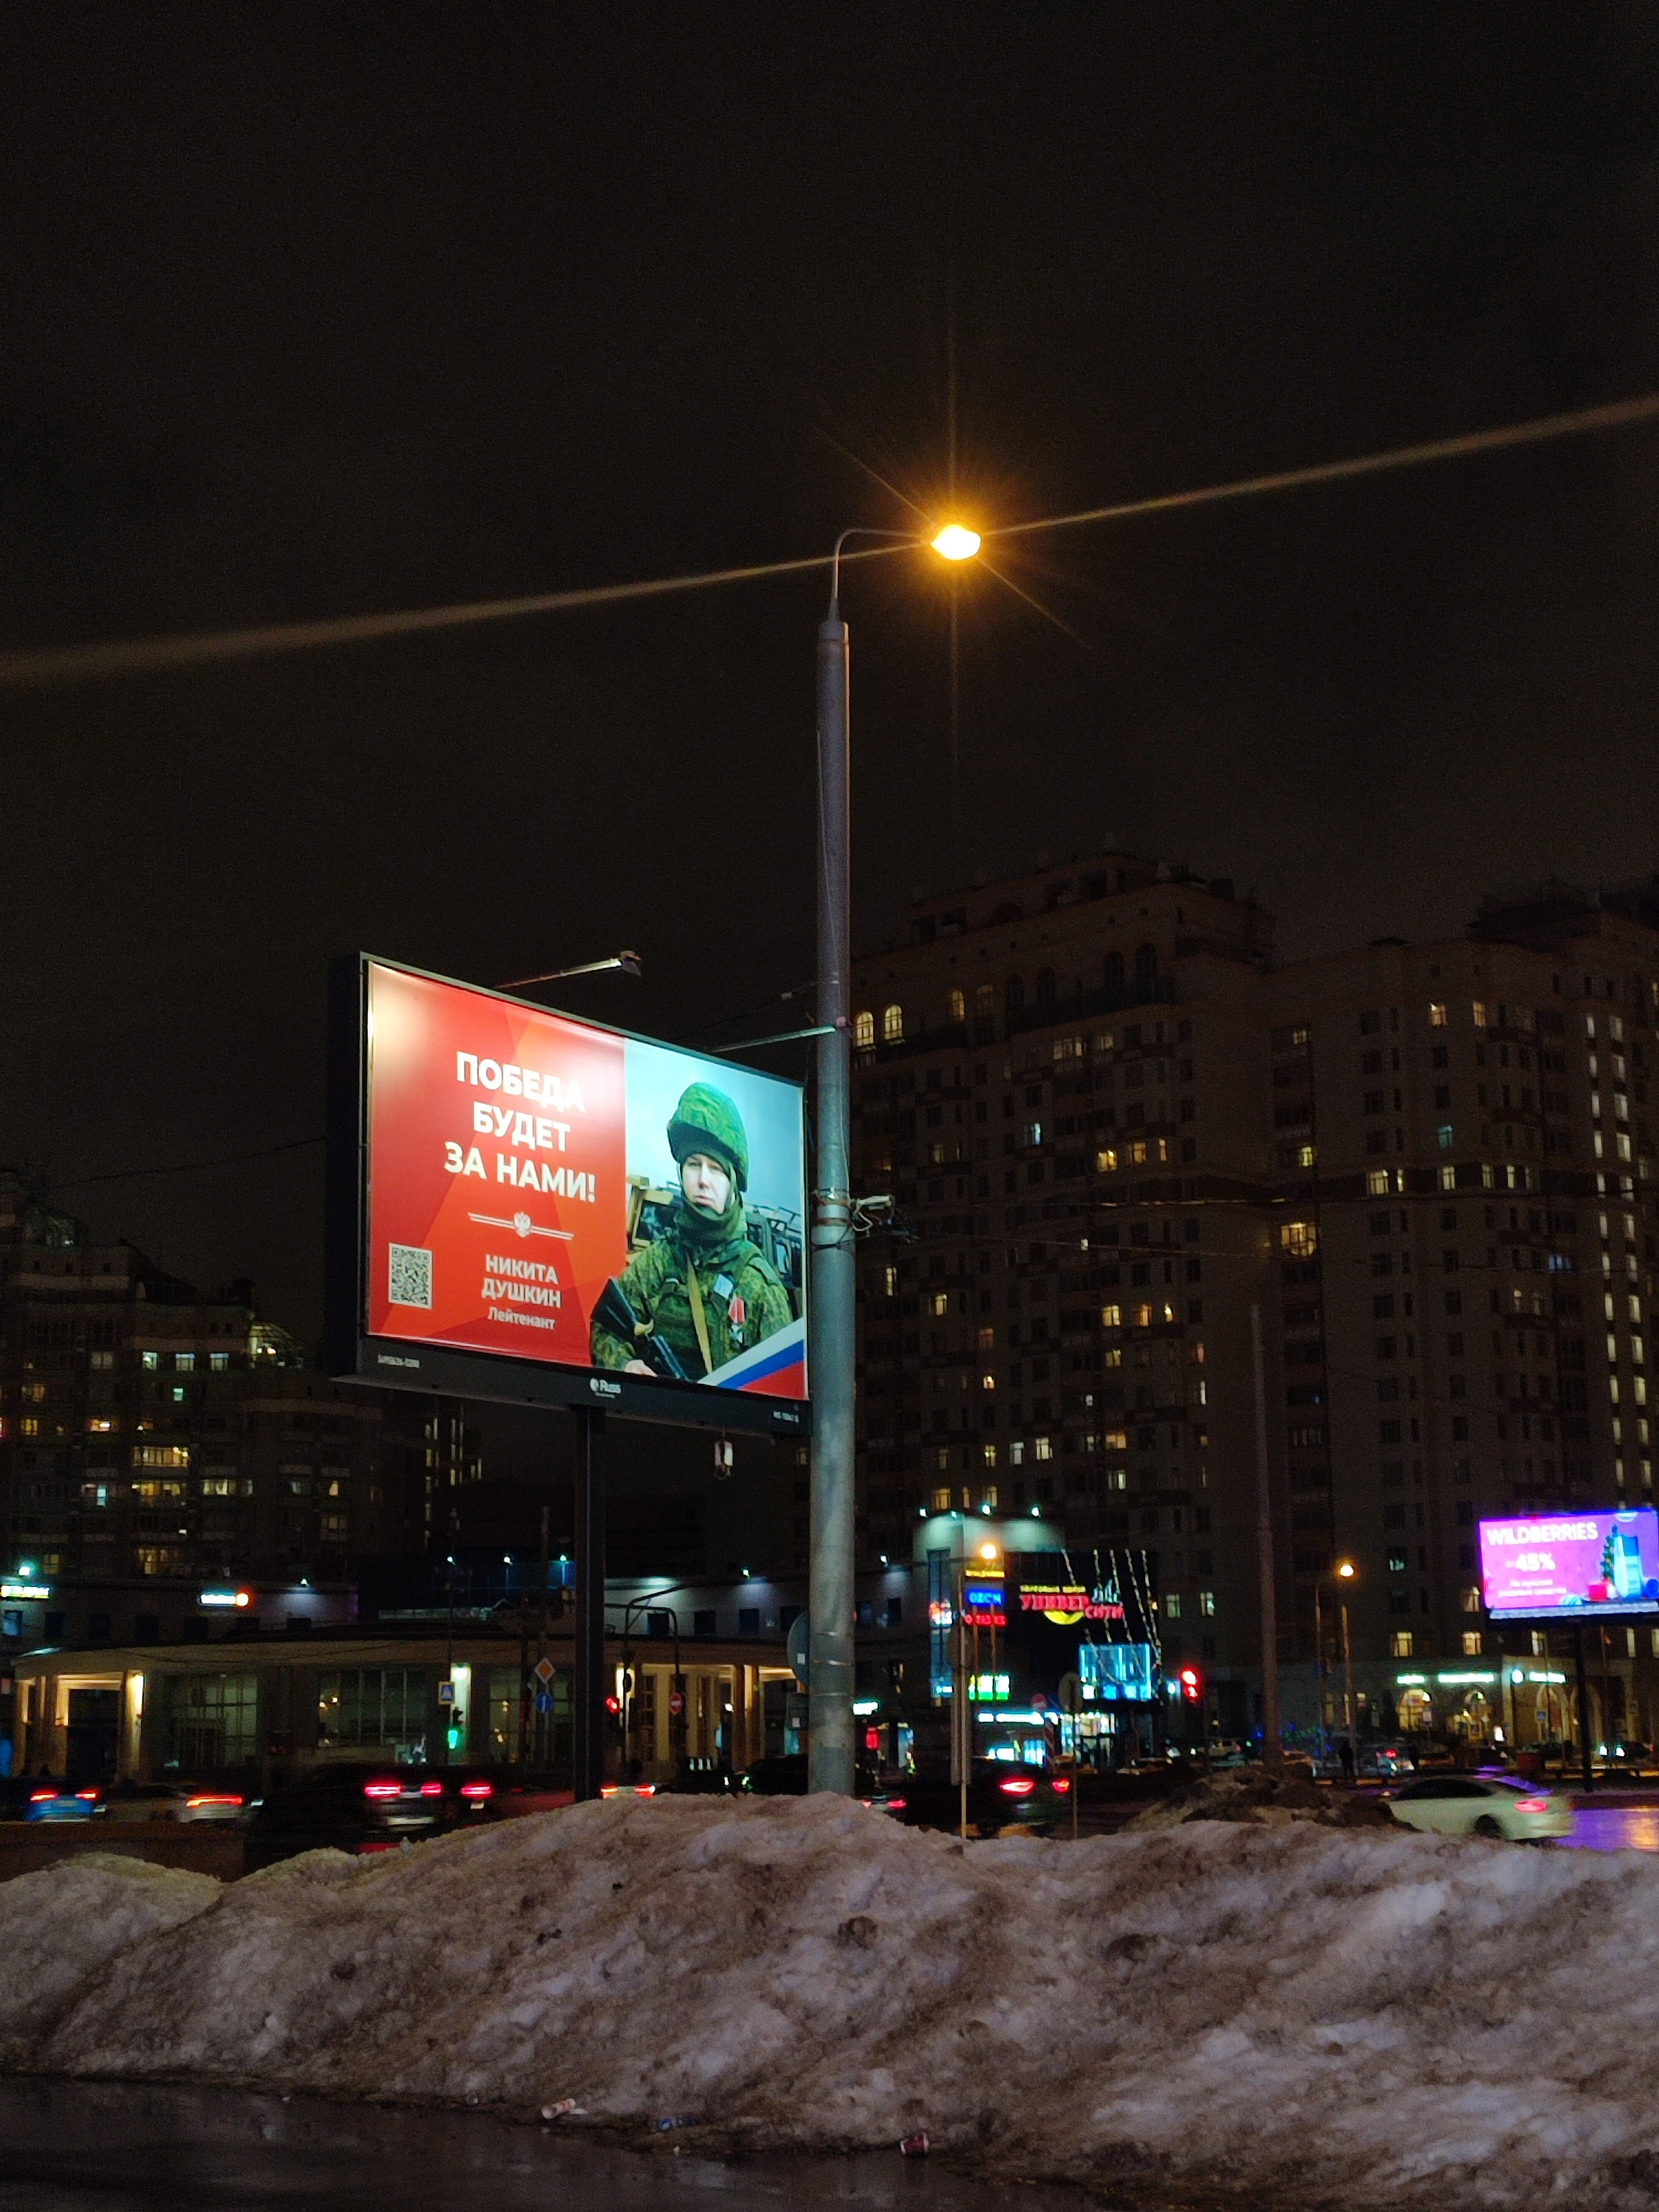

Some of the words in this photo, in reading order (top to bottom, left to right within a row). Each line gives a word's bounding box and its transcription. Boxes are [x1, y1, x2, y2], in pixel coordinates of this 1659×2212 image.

[456, 1051, 586, 1113] ПОБЕДА
[473, 1101, 571, 1152] БУДЕТ
[444, 1141, 487, 1180] ЗА
[496, 1153, 596, 1203] НАМИ!
[485, 1253, 559, 1285] НИКИТА
[481, 1277, 561, 1309] ДУШКИН
[487, 1306, 555, 1330] Лейтенант
[1486, 1522, 1599, 1546] WILDBERRIES
